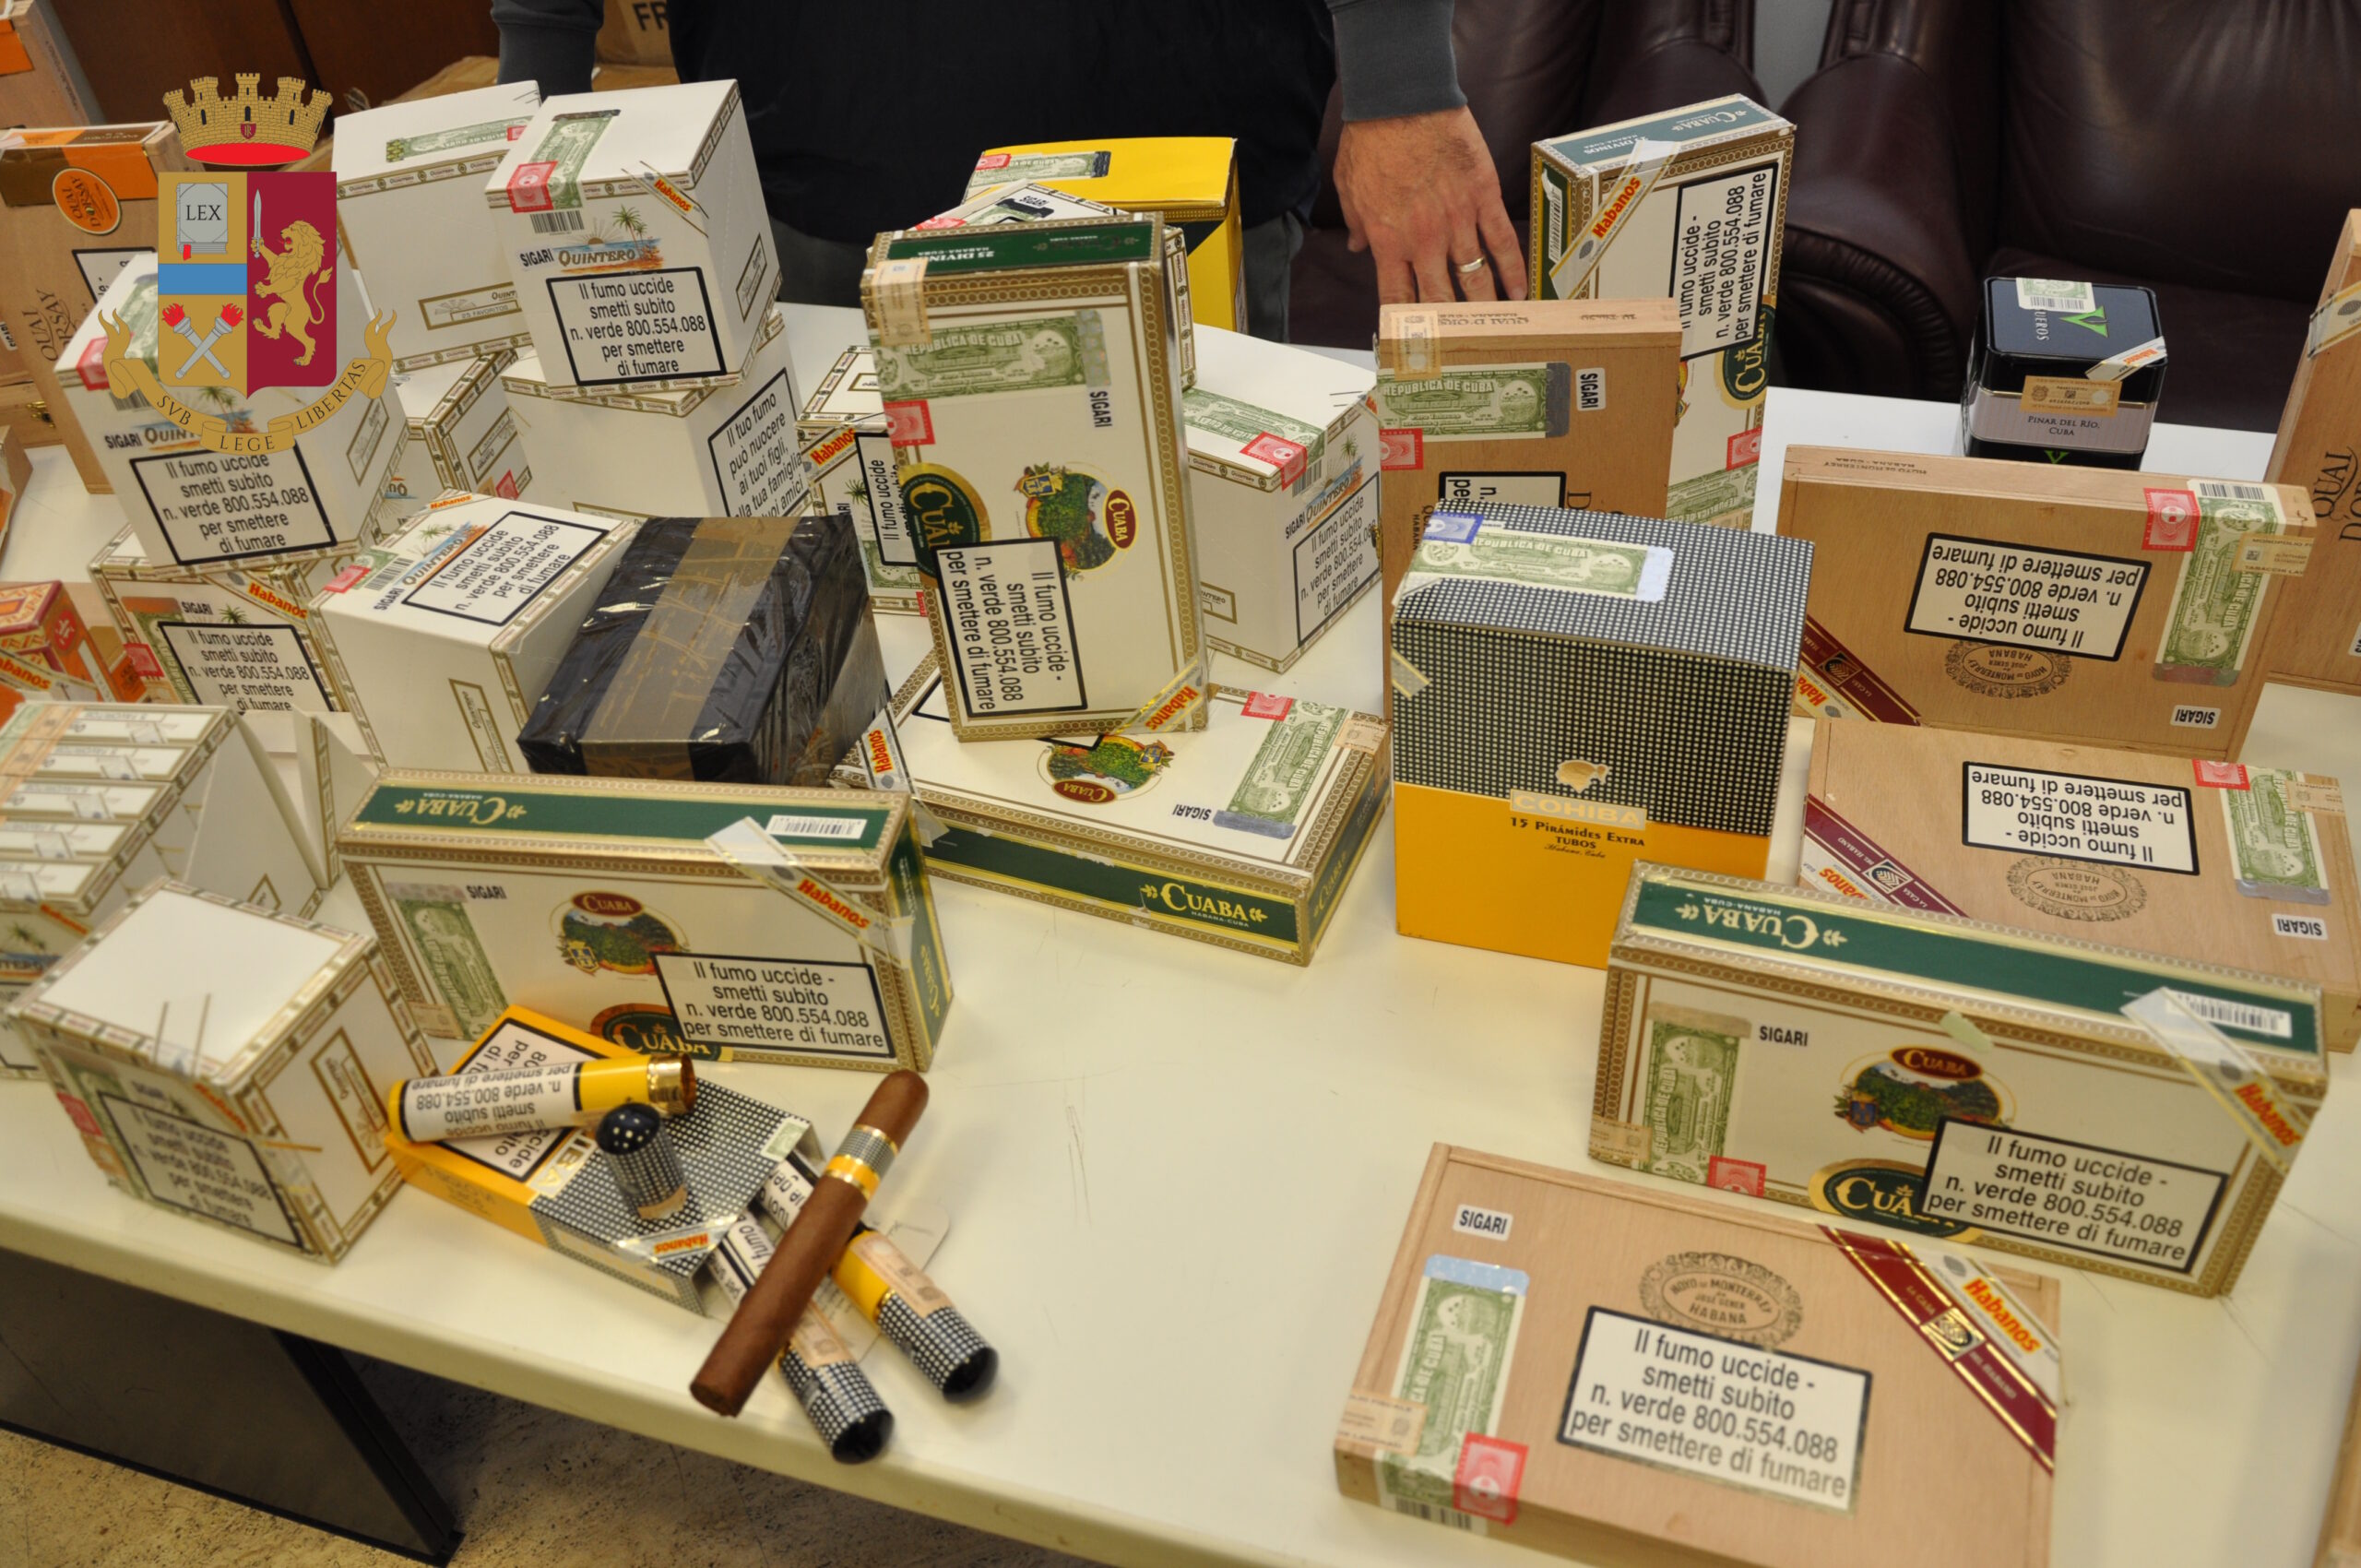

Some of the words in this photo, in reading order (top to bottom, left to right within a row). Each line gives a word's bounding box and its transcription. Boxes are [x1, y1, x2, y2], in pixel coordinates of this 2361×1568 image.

[1684, 112, 1739, 131] CUABA
[653, 176, 694, 213] Habanos
[1742, 172, 1767, 228] fumare
[1591, 177, 1643, 239] Habanos
[1700, 219, 1722, 267] subito
[1740, 229, 1760, 245] di
[519, 248, 554, 267] SIGARI
[558, 248, 635, 268] QUINTERO
[577, 281, 589, 300] Il
[589, 280, 627, 299] fumo
[627, 276, 675, 296] uccide
[1697, 269, 1716, 316] smetti
[1737, 247, 1758, 314] smettere
[588, 298, 632, 320] smetti
[633, 296, 676, 316] subito
[568, 327, 584, 341] n.
[584, 320, 623, 339] verde
[624, 314, 706, 337] 800.554.088
[970, 333, 986, 347] DE
[988, 330, 1024, 347] CUBA
[1733, 316, 1752, 341] per
[599, 343, 623, 362] per
[625, 337, 685, 357] smettere
[1445, 380, 1462, 391] DE
[1463, 381, 1495, 392] CUBA
[1580, 373, 1599, 409] SIGARI
[1089, 390, 1112, 428] SIGARI
[2027, 415, 2057, 426] PINAR
[2059, 418, 2077, 427] DEL
[104, 434, 143, 449] SIGARI
[2048, 426, 2074, 436] CUBA
[730, 445, 748, 481] può
[750, 413, 786, 453] nuocere
[809, 427, 856, 466] Habanos
[179, 476, 226, 499] smetti
[226, 470, 274, 493] subito
[752, 488, 768, 510] tua
[768, 452, 802, 495] famiglia
[1306, 479, 1352, 524] QUINTERO
[1108, 497, 1131, 542] CUABA
[1285, 514, 1305, 540] SIGARI
[938, 550, 967, 576] per
[973, 555, 992, 571] n.
[1931, 544, 1996, 572] fumare
[1997, 553, 2018, 574] di
[2021, 556, 2104, 582] smettere
[1934, 566, 2044, 600] 800.554.088
[2105, 563, 2144, 587] per
[248, 582, 309, 619] Habanos
[374, 588, 405, 612] SIGARI
[977, 573, 1006, 615] verde
[1005, 582, 1037, 627] smetti
[1964, 592, 2021, 616] subito
[2047, 582, 2098, 604] verde
[2106, 589, 2122, 607] n.
[181, 601, 214, 616] SIGARI
[950, 578, 981, 642] smettere
[2022, 600, 2081, 623] smetti
[965, 645, 991, 659] di
[986, 618, 1025, 702] 800.554.088
[1014, 630, 1043, 674] subito
[1988, 647, 2033, 661] HABANA
[1967, 658, 2016, 681] MONTERREY
[2025, 665, 2047, 682] HOYO
[969, 661, 996, 710] fumare
[1145, 685, 1199, 731] Habanos
[2174, 708, 2216, 726] SIGARI
[870, 729, 894, 774] Habanos
[1062, 782, 1109, 802] CUABA
[1970, 769, 2036, 793] fumare
[2040, 778, 2058, 796] di
[2063, 781, 2146, 803] smettere
[417, 797, 507, 825] CUABA
[1515, 795, 1641, 826] COHIBA
[2151, 790, 2183, 808] per
[1172, 803, 1212, 821] SIGARI
[2016, 810, 2076, 832] subito
[1511, 817, 1528, 828] 15
[1607, 832, 1645, 846] EXTRA
[2017, 828, 2081, 849] uccide
[2081, 818, 2140, 838] smetti
[1556, 837, 1596, 849] TUBOS
[2086, 837, 2137, 861] fumo
[2142, 844, 2153, 862] Il
[2052, 871, 2100, 885] HABANA
[466, 885, 507, 900] SIGARI
[582, 894, 635, 912] CUABA
[1160, 880, 1249, 922] CUABA
[2031, 879, 2089, 904] MONTERREY
[2097, 888, 2120, 903] HOYO
[796, 878, 872, 931] Habanos
[1703, 905, 1820, 949] CUABA
[2276, 920, 2323, 937] SIGARI
[682, 1020, 712, 1039] per
[716, 1022, 795, 1041] smettere
[798, 1025, 817, 1043] di
[818, 1026, 884, 1048] fumare
[1759, 1025, 1809, 1048] SIGARI
[1904, 1049, 1968, 1079] CUABA
[2233, 1081, 2303, 1146] Habanos
[1458, 1209, 1508, 1236] SIGARI
[1926, 1193, 1967, 1213] per
[1970, 1202, 2070, 1236] smettere
[2075, 1222, 2100, 1242] di
[2104, 1227, 2186, 1261] fumare
[1670, 1278, 1698, 1297] HOYO
[1709, 1278, 1773, 1314] MONTERREY
[1689, 1303, 1748, 1326] HABANA
[1963, 1276, 2042, 1354] Habanos
[1633, 1326, 1651, 1354] Il
[1654, 1332, 1714, 1371] fumo
[1720, 1354, 1805, 1391] uccide
[1589, 1383, 1610, 1407] n.
[1619, 1389, 1687, 1425] verde
[1691, 1403, 1838, 1464] 800.554.088
[1568, 1408, 1613, 1437] per
[1616, 1420, 1723, 1467] smettere
[1728, 1445, 1753, 1474] di
[1760, 1451, 1849, 1506] fumare
